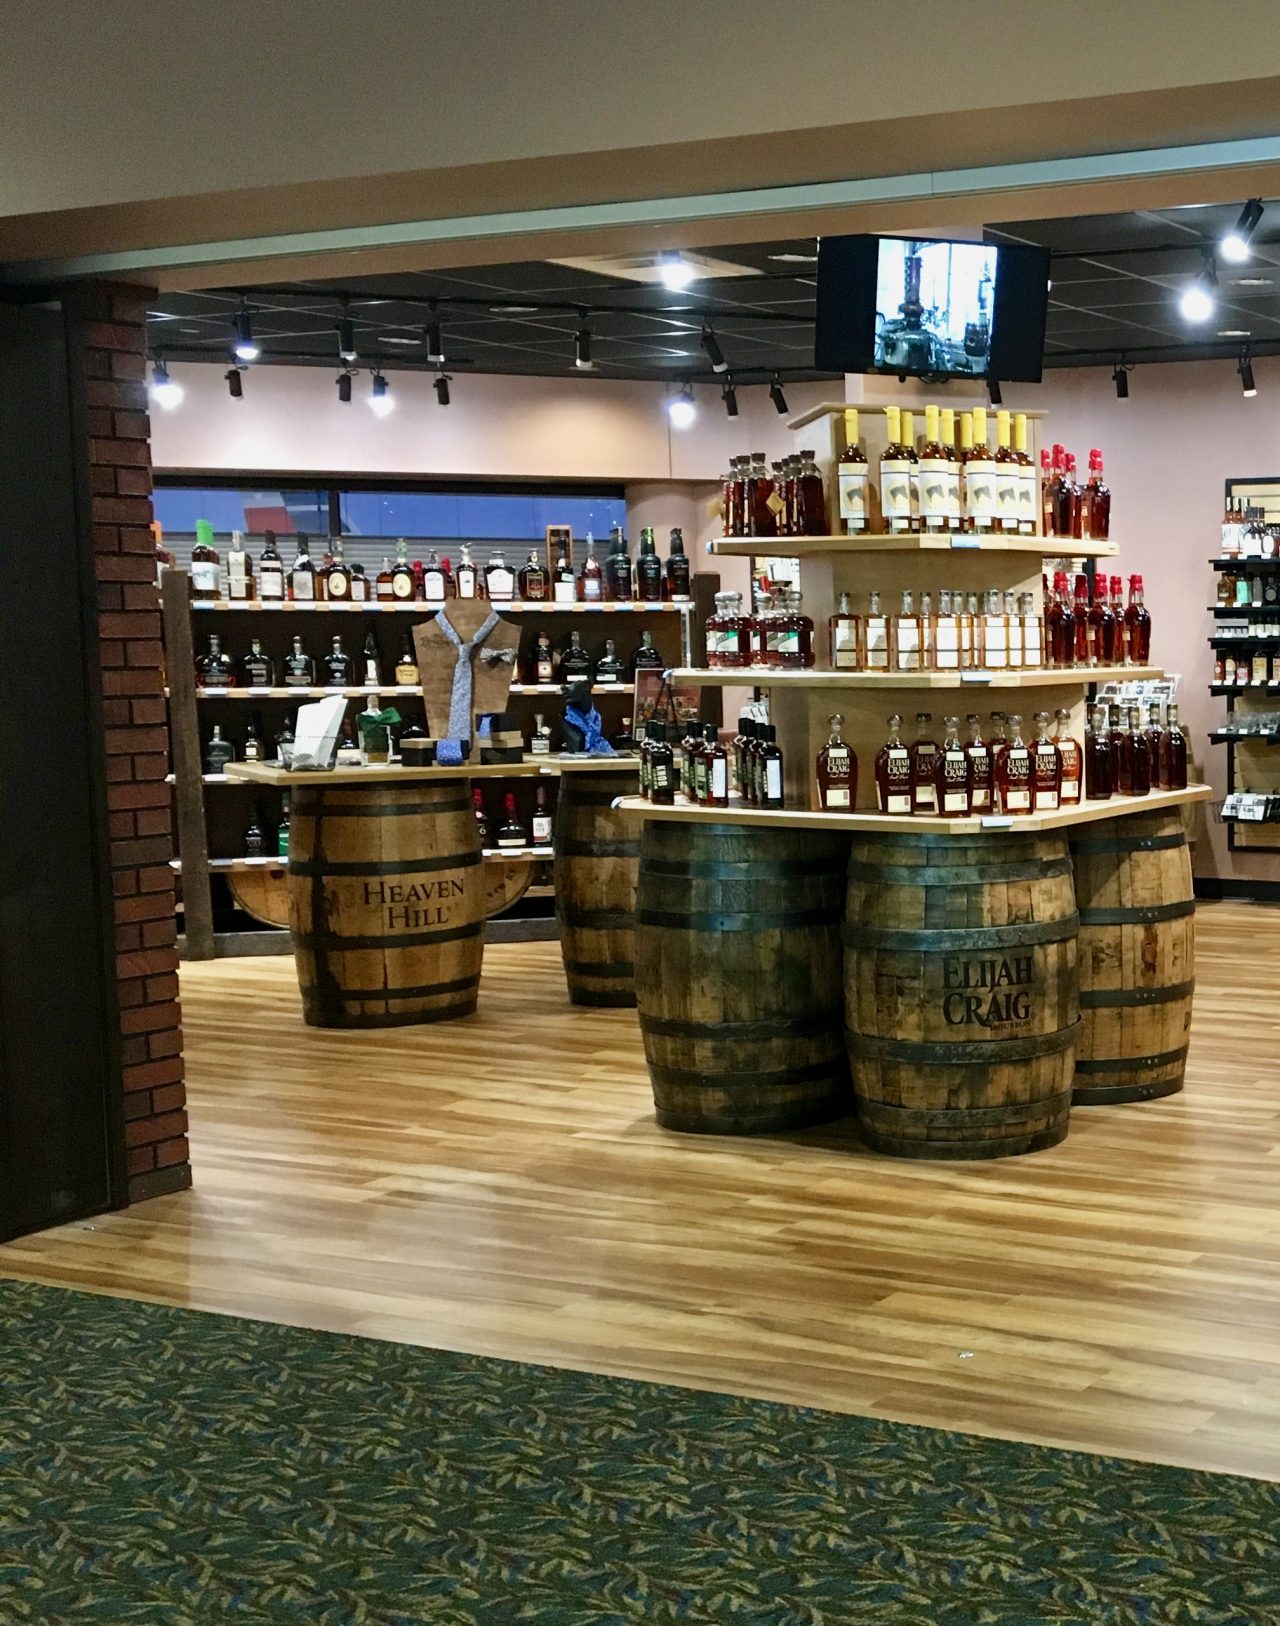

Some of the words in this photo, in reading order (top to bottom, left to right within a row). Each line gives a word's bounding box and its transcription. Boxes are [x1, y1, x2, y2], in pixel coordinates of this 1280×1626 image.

[827, 757, 850, 765] ELIJAH
[887, 758, 910, 766] ELIJAH
[1007, 758, 1029, 766] ELIJAH
[1035, 754, 1057, 762] ELIJAH
[827, 764, 850, 774] CRAIG
[887, 765, 910, 775] CRAIG
[944, 761, 967, 769] ELIJAH
[973, 763, 989, 772] RAIG
[1007, 765, 1030, 775] CRAIG
[1035, 761, 1057, 770] CRAIG
[656, 764, 668, 787] KNOB
[944, 767, 967, 777] CRAIG
[363, 878, 465, 905] HEAVEN
[387, 905, 449, 929] HILL
[942, 956, 1034, 993] ELIJAH
[942, 992, 1032, 1028] CRAIG
